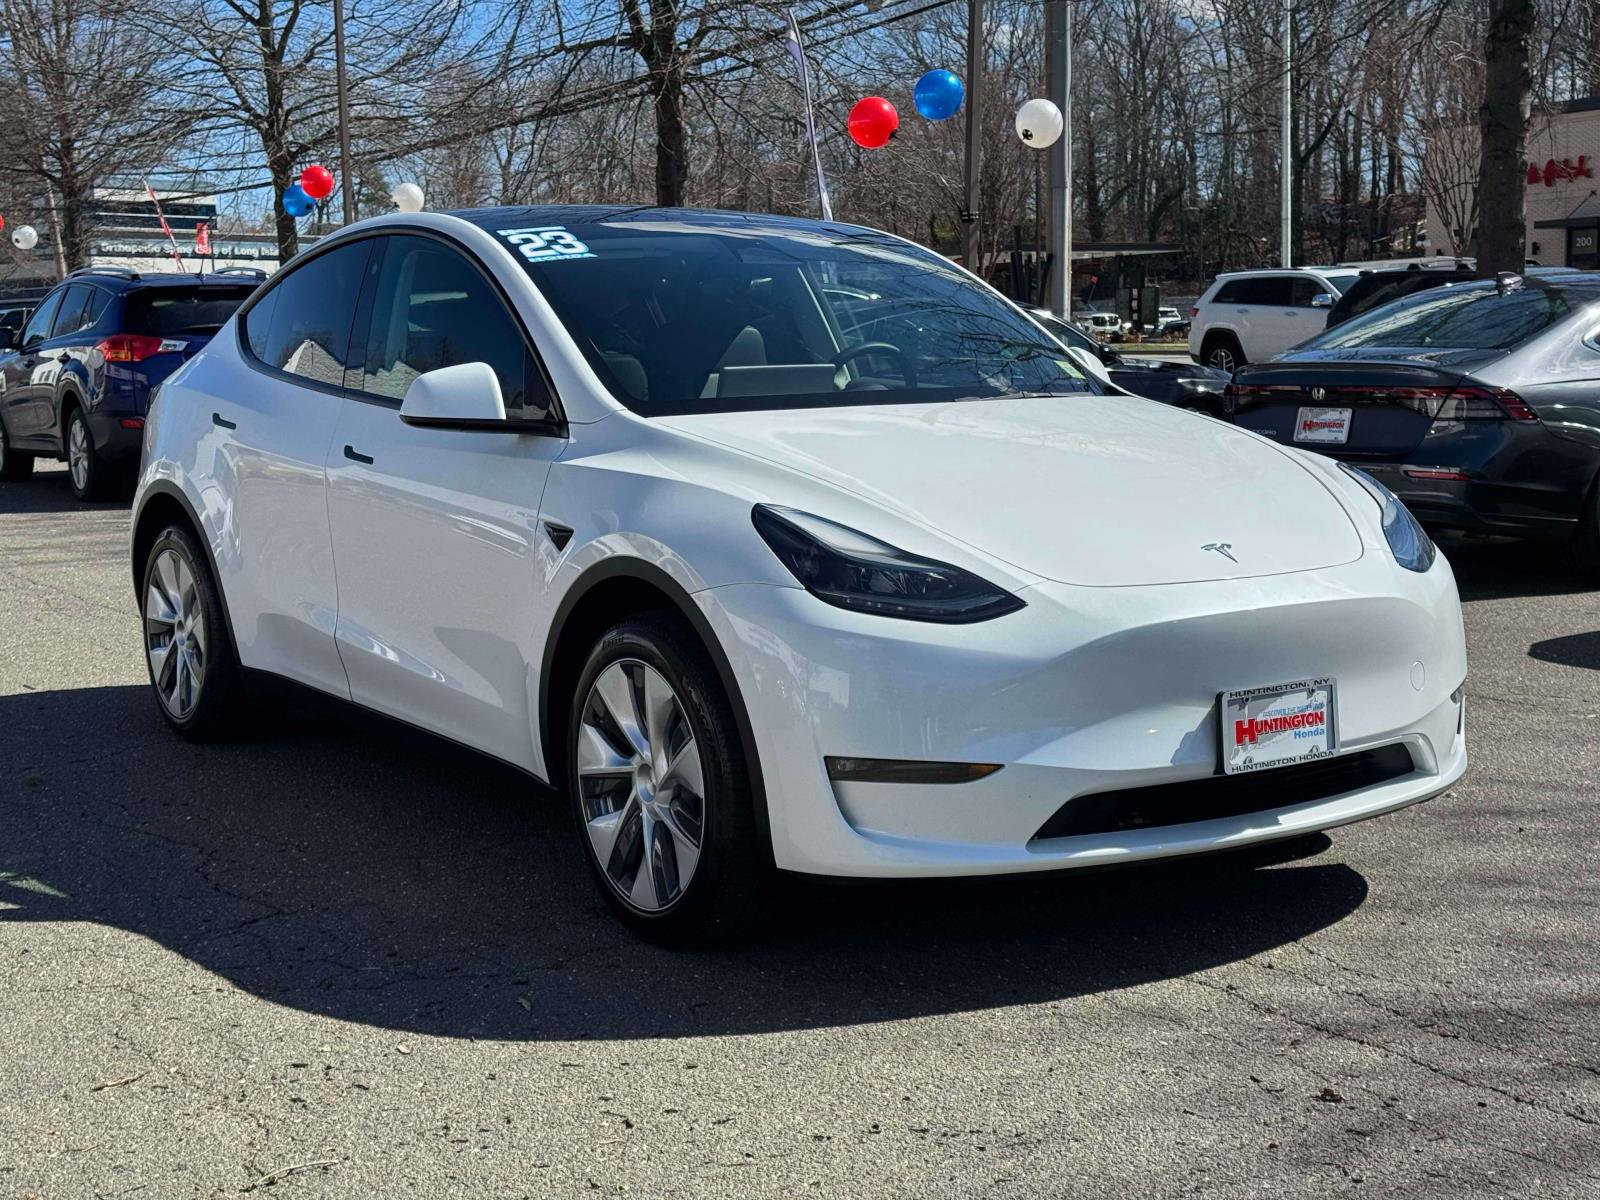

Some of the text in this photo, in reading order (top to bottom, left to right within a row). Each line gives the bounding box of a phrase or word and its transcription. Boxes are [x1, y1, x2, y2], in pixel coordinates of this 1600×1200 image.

[101, 242, 160, 254] Orthopedic
[163, 243, 192, 255] Spne
[221, 245, 232, 255] of
[234, 246, 259, 258] Long
[507, 231, 590, 258] 23
[1576, 237, 1592, 247] 200
[1313, 678, 1330, 687] NY
[1235, 711, 1325, 746] HUNTINGTON
[1294, 727, 1325, 739] Honda
[1231, 750, 1335, 773] HUNTINGTON HONDA
